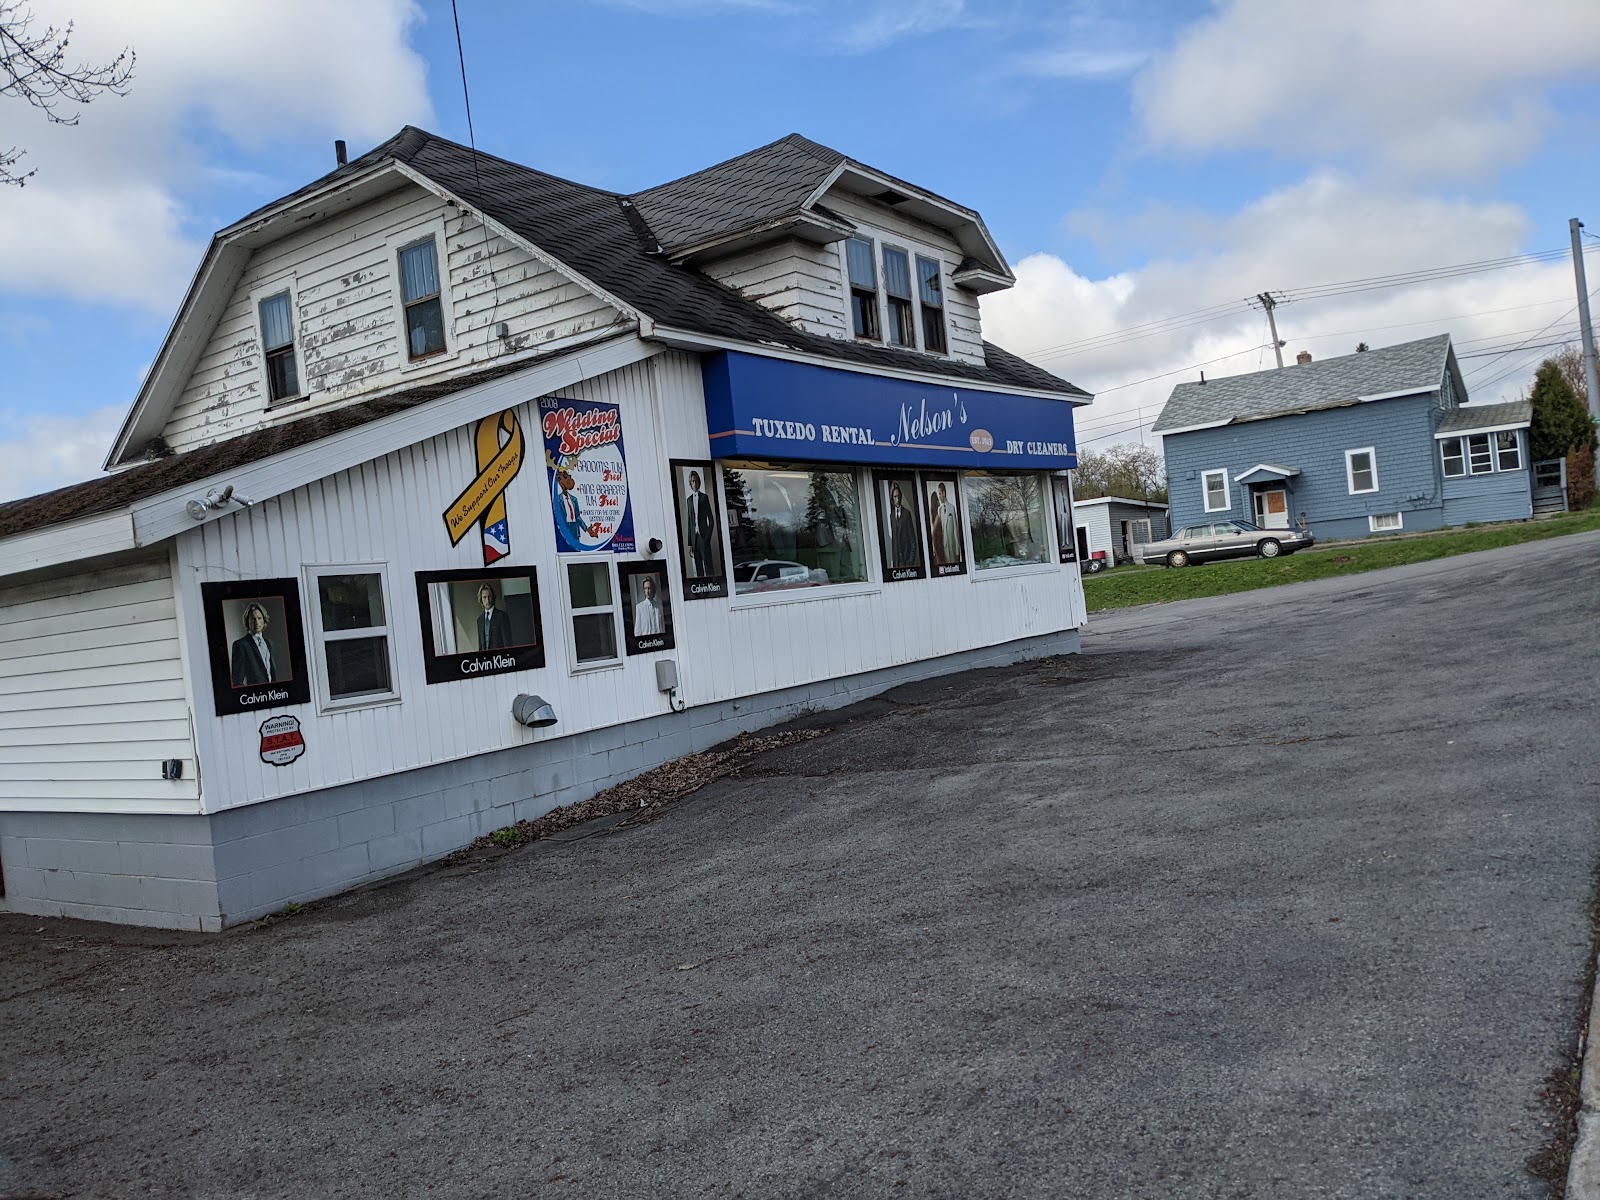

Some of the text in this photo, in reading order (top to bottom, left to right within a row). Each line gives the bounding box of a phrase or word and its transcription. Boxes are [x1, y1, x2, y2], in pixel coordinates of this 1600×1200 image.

[540, 397, 559, 408] 2008
[543, 407, 618, 439] Wedding
[890, 392, 968, 446] Nelson's
[559, 424, 620, 455] Special
[752, 417, 875, 446] TUXEDO RENTAL
[1006, 440, 1068, 456] DRY CLEANERS
[450, 452, 519, 528] We Support Our Troops
[690, 582, 721, 593] Calvin Klein
[638, 638, 665, 649] Calvin Klein
[461, 653, 516, 673] Calvin Klein
[240, 684, 289, 705] Calvin Klein
[264, 719, 295, 731] WARNING!
